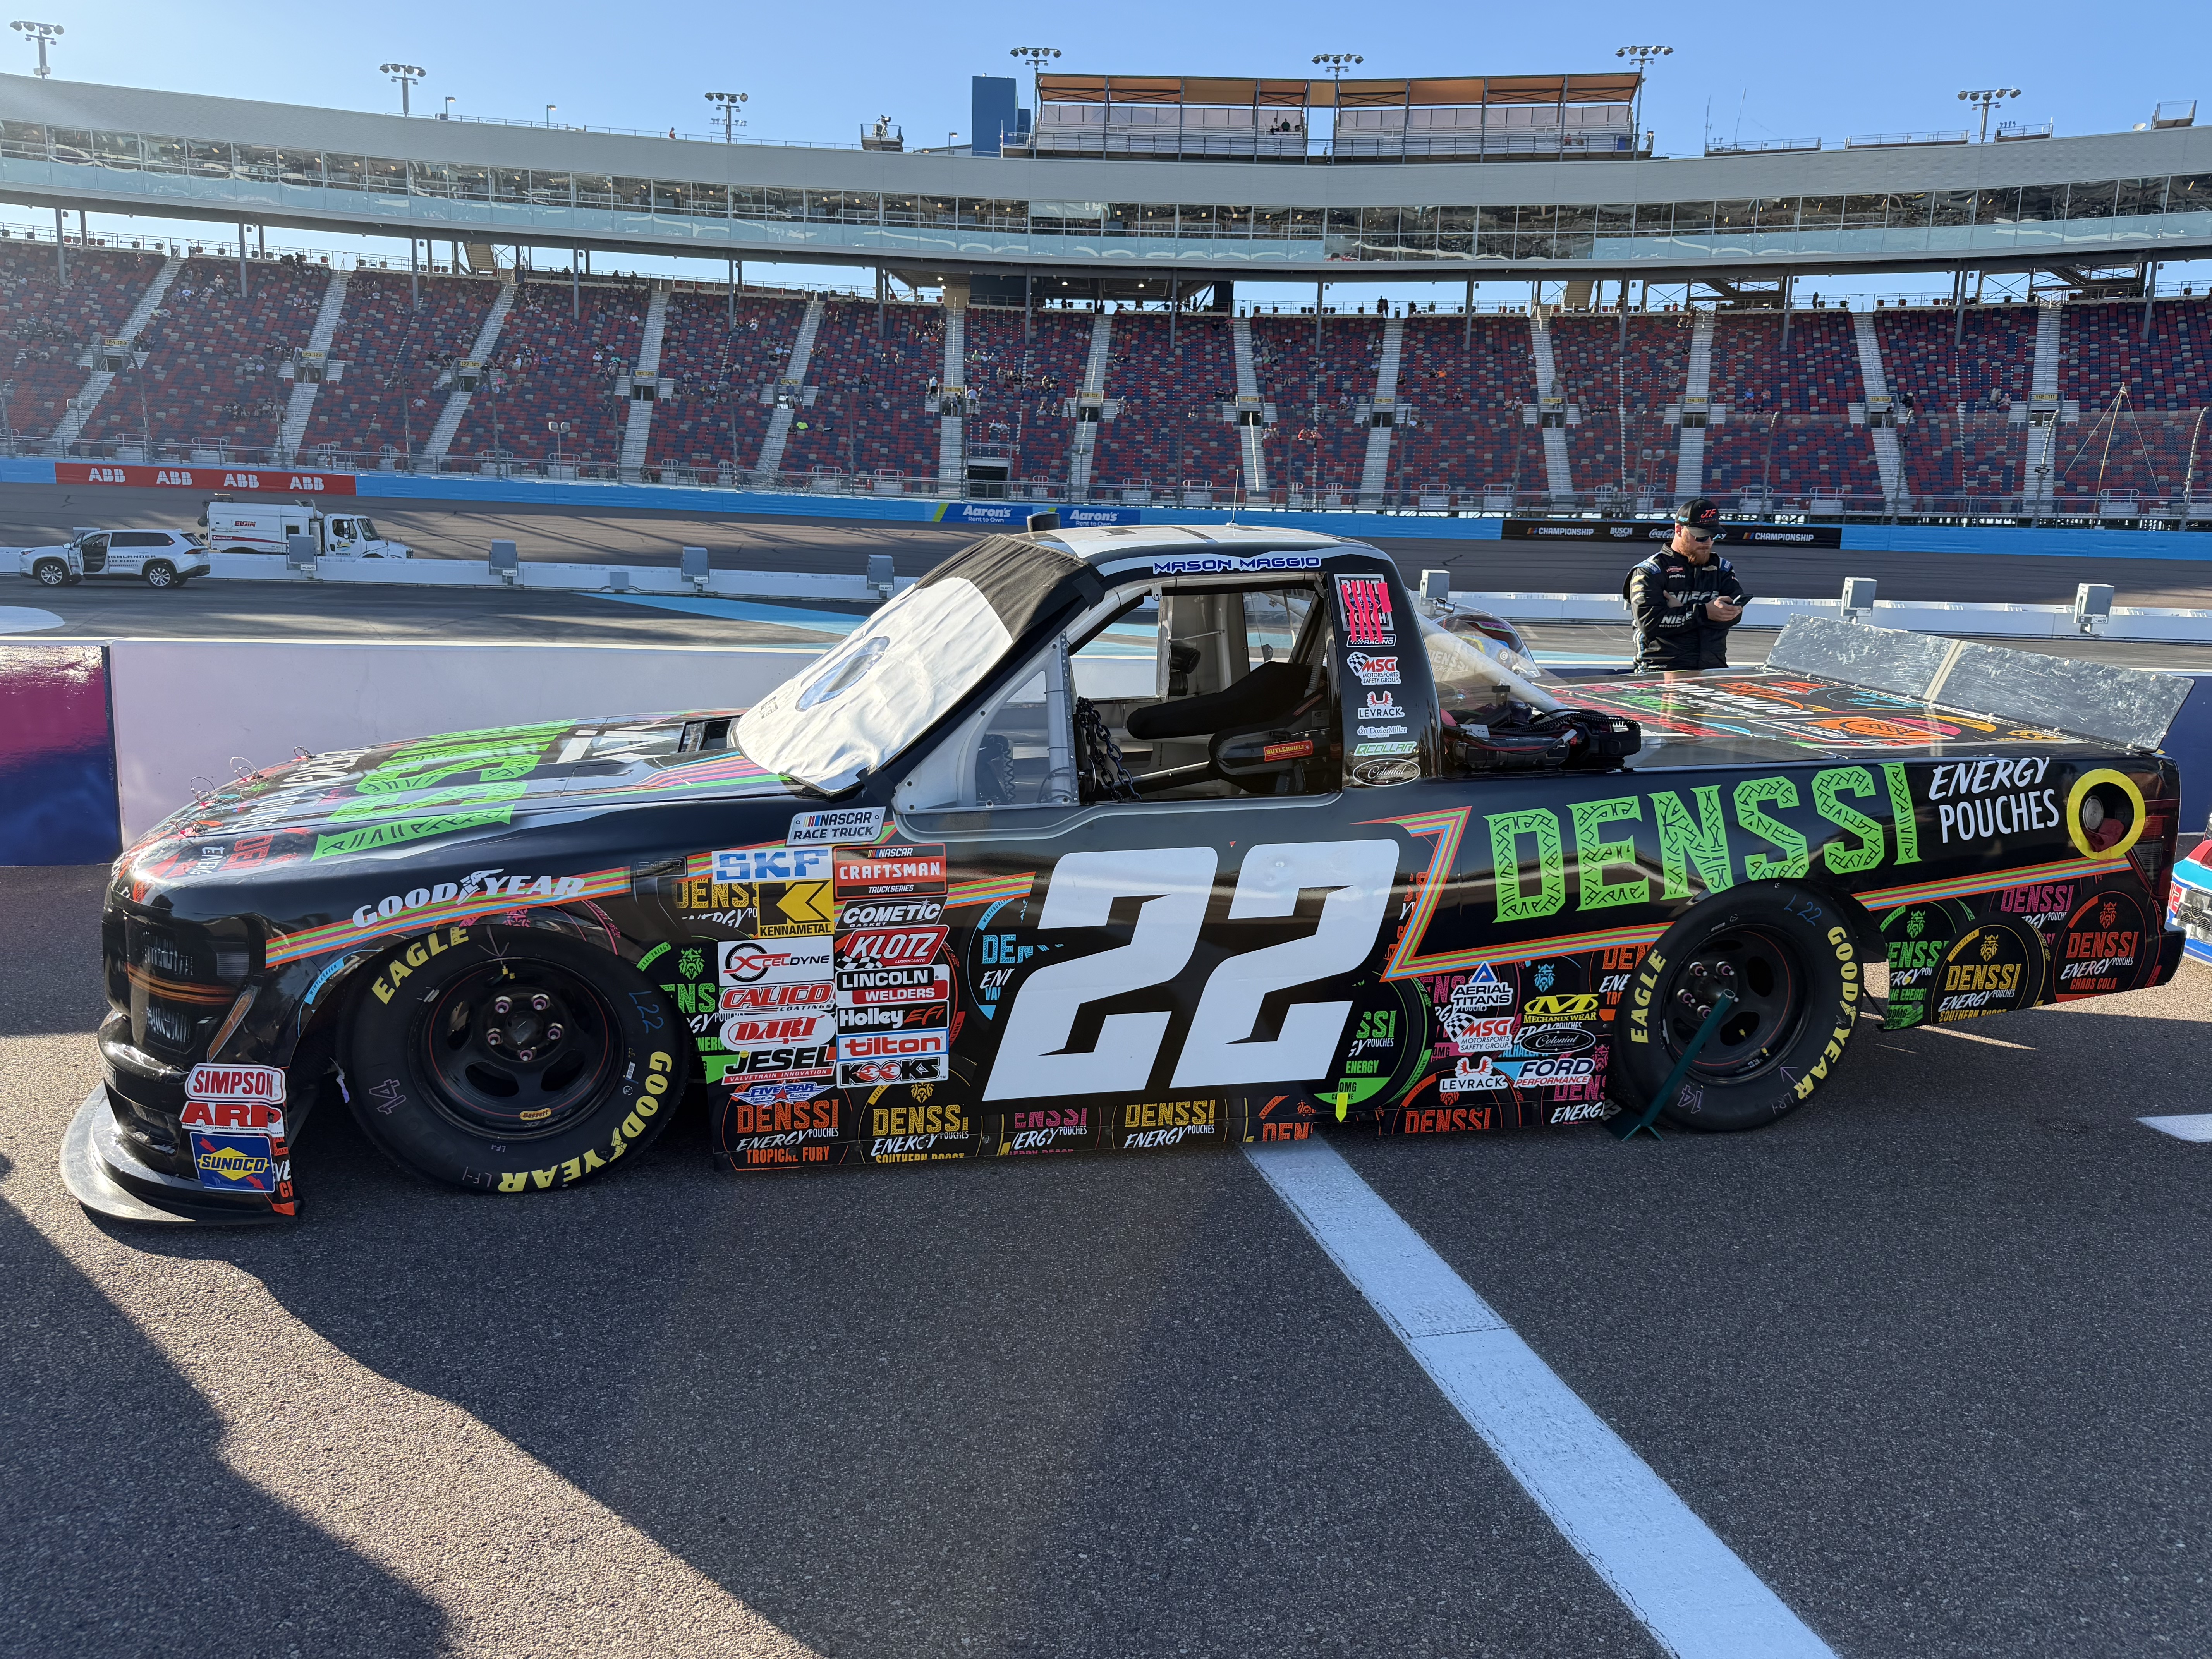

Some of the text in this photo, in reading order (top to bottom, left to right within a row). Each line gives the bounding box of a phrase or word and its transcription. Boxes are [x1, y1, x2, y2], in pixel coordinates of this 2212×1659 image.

[89, 468, 125, 483] ABB
[156, 471, 192, 485] ABB
[224, 474, 259, 488] ABB
[290, 476, 325, 491] ABB
[963, 505, 1011, 518] Aaron's
[1070, 509, 1118, 522] Aaron's
[1538, 527, 1594, 536] CHAMPIONSHIP
[1755, 532, 1814, 542] CHAMPIONSHIP
[1154, 557, 1320, 572] MASON MAGGIO
[1362, 658, 1397, 672] MSG
[1359, 708, 1402, 718] LEVRACK
[1370, 725, 1407, 734] DozierMiller
[1266, 744, 1305, 755] BUTLERBUILT
[1356, 743, 1415, 755] QCOLLAR
[1367, 766, 1407, 779] Colonial
[1928, 757, 2050, 801] ENERGY
[820, 811, 872, 826] NASCAR
[1939, 789, 2059, 843] POUCHES
[793, 826, 874, 840] RACE TRUCK
[1483, 761, 1923, 923] DENSSI
[879, 848, 913, 857] NASCAR
[716, 850, 829, 881] SKF
[839, 862, 941, 880] CRAFTSMAN
[352, 868, 585, 928] GOODYEAR
[869, 884, 914, 894] TRUCK SERIES
[2001, 885, 2075, 913] DENSSI
[843, 902, 940, 925] COMETIC
[1784, 894, 1822, 926] L 22
[2048, 912, 2068, 921] POUCH
[760, 924, 831, 937] KENNAMETAL
[651, 943, 670, 958] ENERGY
[851, 932, 940, 959] KLOTZ
[2066, 931, 2140, 958] DENSSI
[371, 926, 470, 1005] EAGLE
[723, 953, 831, 974] XCELDYNE
[982, 838, 1401, 1101] 22
[2060, 956, 2134, 981] ENERGY POUCHES
[842, 969, 928, 988] LINCOLN
[1944, 963, 2022, 991] DENSSI
[2070, 977, 2117, 990] CHAOS COLA
[721, 983, 834, 1011] CALICO
[865, 988, 936, 1002] WELDERS
[1454, 984, 1511, 996] AERIAL
[1630, 949, 1667, 1044] EAGLE
[1454, 994, 1510, 1006] TITANS
[1938, 989, 2015, 1012] ENERGY POUCHES
[628, 991, 664, 1034] L 22
[839, 1005, 945, 1029] Holley EFI
[1523, 1012, 1597, 1024] MECHANIX WEAR
[1793, 926, 1859, 1100] GOODYEAR
[1939, 1009, 1979, 1022] SOUTHERN
[735, 1014, 826, 1044] DART
[1462, 1019, 1512, 1038] MSG
[845, 1037, 942, 1057] tilton
[1367, 1037, 1394, 1048] POUCHES
[1461, 1036, 1510, 1045] MOTORSPORTS
[1535, 1034, 1580, 1048] Colonial
[725, 1046, 835, 1075] JESEL
[1345, 1060, 1379, 1074] ENERGY
[1518, 1059, 1594, 1078] FORD
[730, 1068, 828, 1082] VALVETRAIN INNOVATION
[840, 1058, 940, 1085] KOOKS
[1515, 1075, 1589, 1086] PERFORMANCE
[193, 1070, 274, 1097] SIMPSON
[751, 1084, 813, 1094] FIVE STAR
[1442, 1078, 1504, 1090] LEVRACK
[369, 1078, 407, 1115] 14
[181, 1101, 282, 1128] ARP
[498, 1051, 673, 1192] GOODYEAR
[523, 1109, 549, 1118] Bassett
[737, 1099, 840, 1133] DENSSI
[872, 1104, 969, 1137] DENSSI
[1124, 1099, 1217, 1128] DENSSI
[1405, 1108, 1491, 1134] DENSSI
[736, 1127, 839, 1152] ENERGY POUCHES
[1058, 1125, 1087, 1136] POUCHES
[1123, 1124, 1215, 1149] ENERGY POUCHES
[870, 1130, 969, 1157] ENERGY POUCHES
[201, 1156, 266, 1172] SUNOCO
[746, 1146, 830, 1164] TROPICAL FURY
